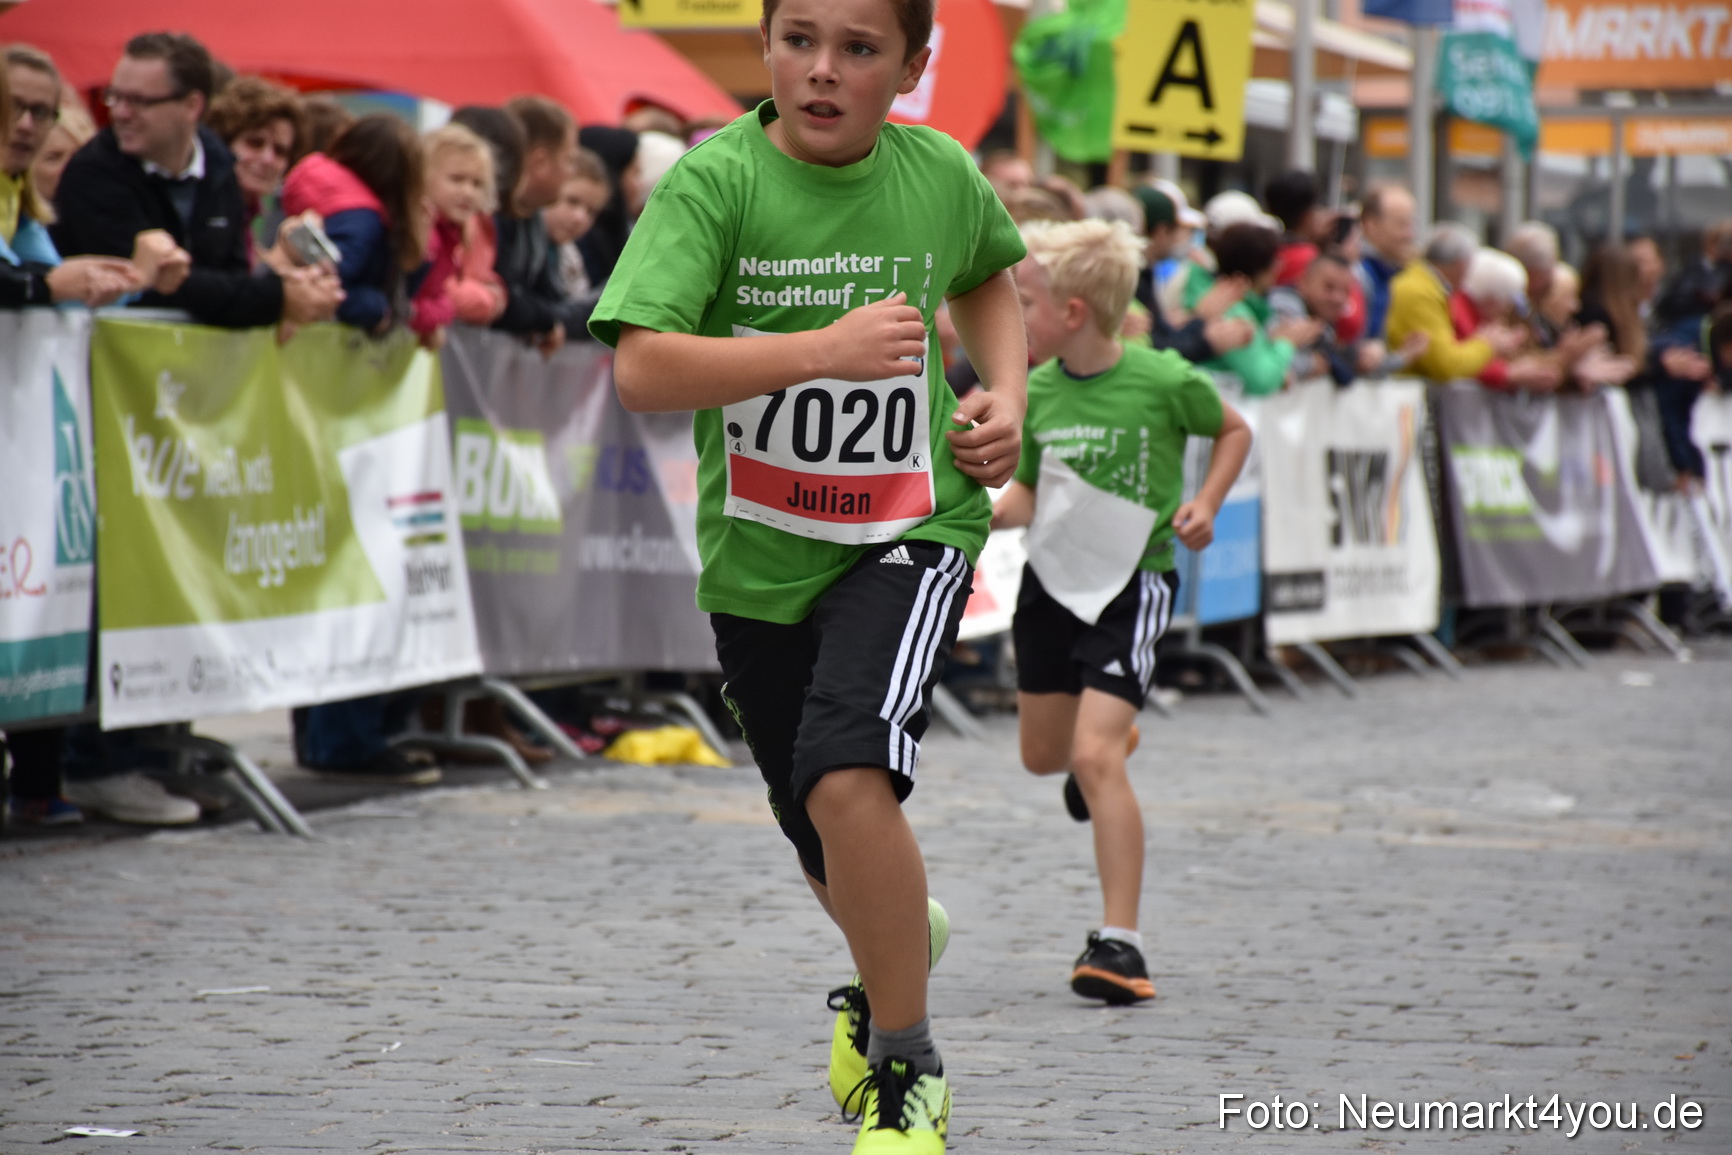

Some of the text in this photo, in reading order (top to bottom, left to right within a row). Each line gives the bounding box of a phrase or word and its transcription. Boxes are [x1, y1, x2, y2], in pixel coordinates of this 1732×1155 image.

[1147, 18, 1214, 110] A
[738, 251, 884, 277] Neumarkter
[736, 282, 856, 309] Stadtlauf
[754, 387, 916, 465] 7020
[734, 441, 742, 453] 4
[912, 455, 921, 468] K
[786, 480, 871, 516] Julian
[879, 556, 915, 566] adidas
